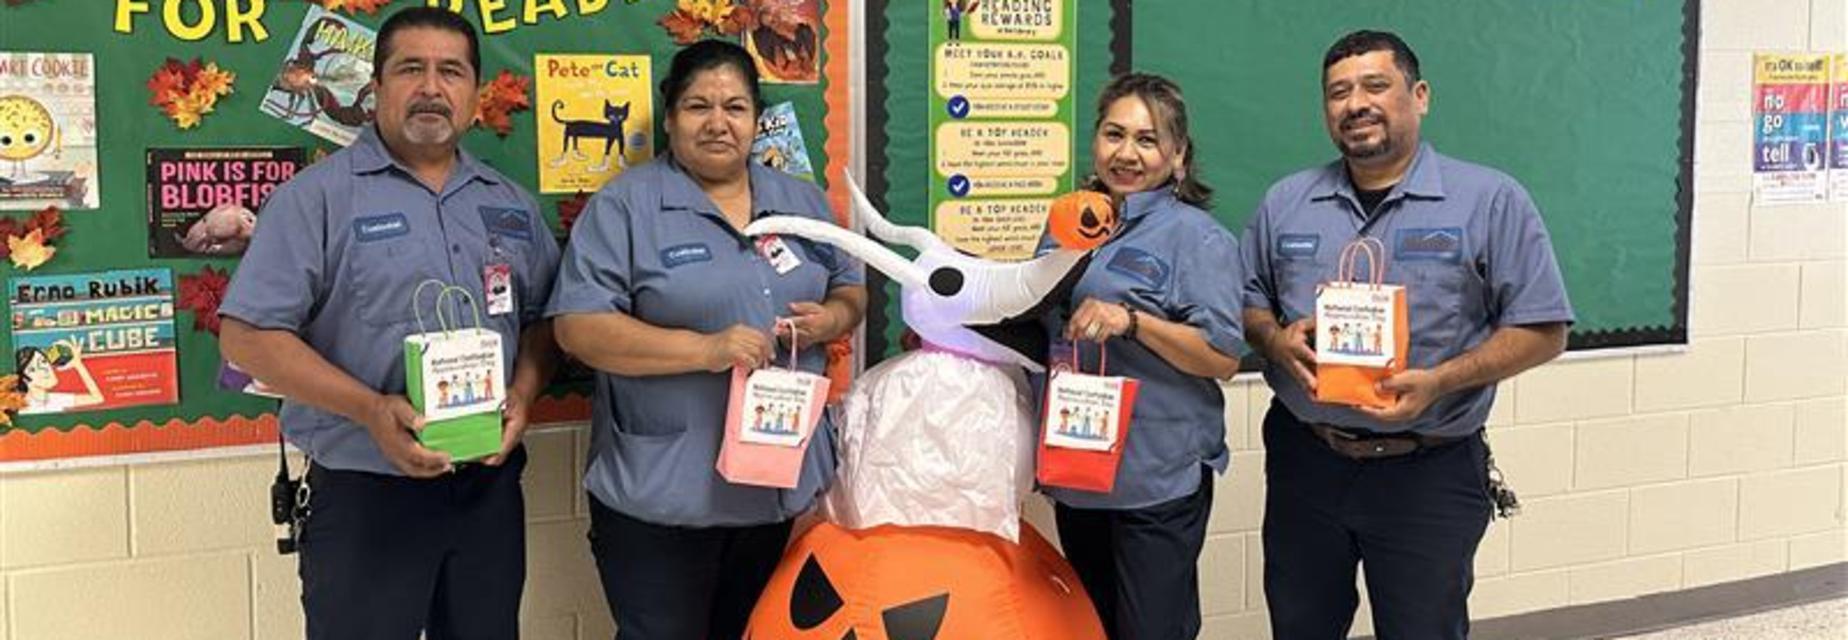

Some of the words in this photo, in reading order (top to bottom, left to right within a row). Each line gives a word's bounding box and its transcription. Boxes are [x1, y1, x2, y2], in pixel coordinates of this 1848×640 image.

[114, 0, 270, 43] FOR
[981, 14, 1052, 26] REWARDS
[33, 59, 90, 79] COOKIE
[548, 58, 591, 78] Pete
[606, 60, 641, 78] Cat
[1764, 93, 1785, 110] no
[1763, 115, 1784, 135] go
[1763, 143, 1790, 163] tell
[161, 162, 218, 181] PINK
[223, 162, 246, 181] IS
[252, 161, 296, 182] FOR
[161, 182, 277, 210] BLOBFIS
[17, 284, 76, 303] Erno
[89, 276, 160, 298] Rubik
[84, 304, 160, 324] MAGIC
[88, 328, 160, 352] CUBE
